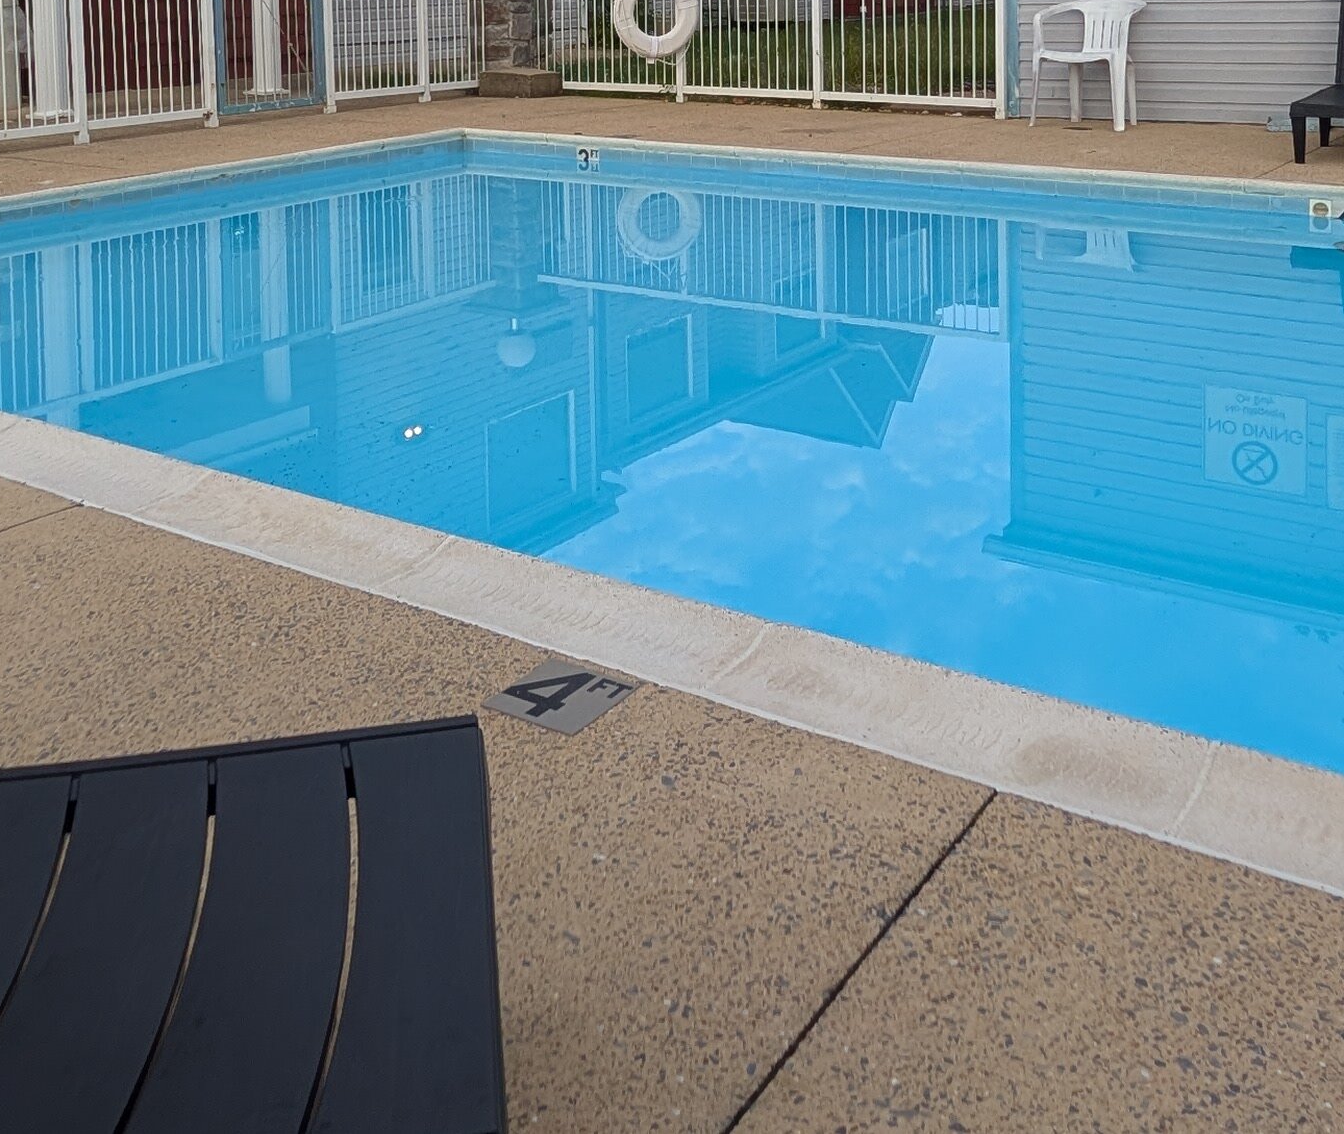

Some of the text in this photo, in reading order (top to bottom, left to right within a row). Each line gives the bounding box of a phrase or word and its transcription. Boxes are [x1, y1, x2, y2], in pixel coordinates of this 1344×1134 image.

[590, 149, 599, 158] FT
[502, 672, 633, 717] 4 FT
